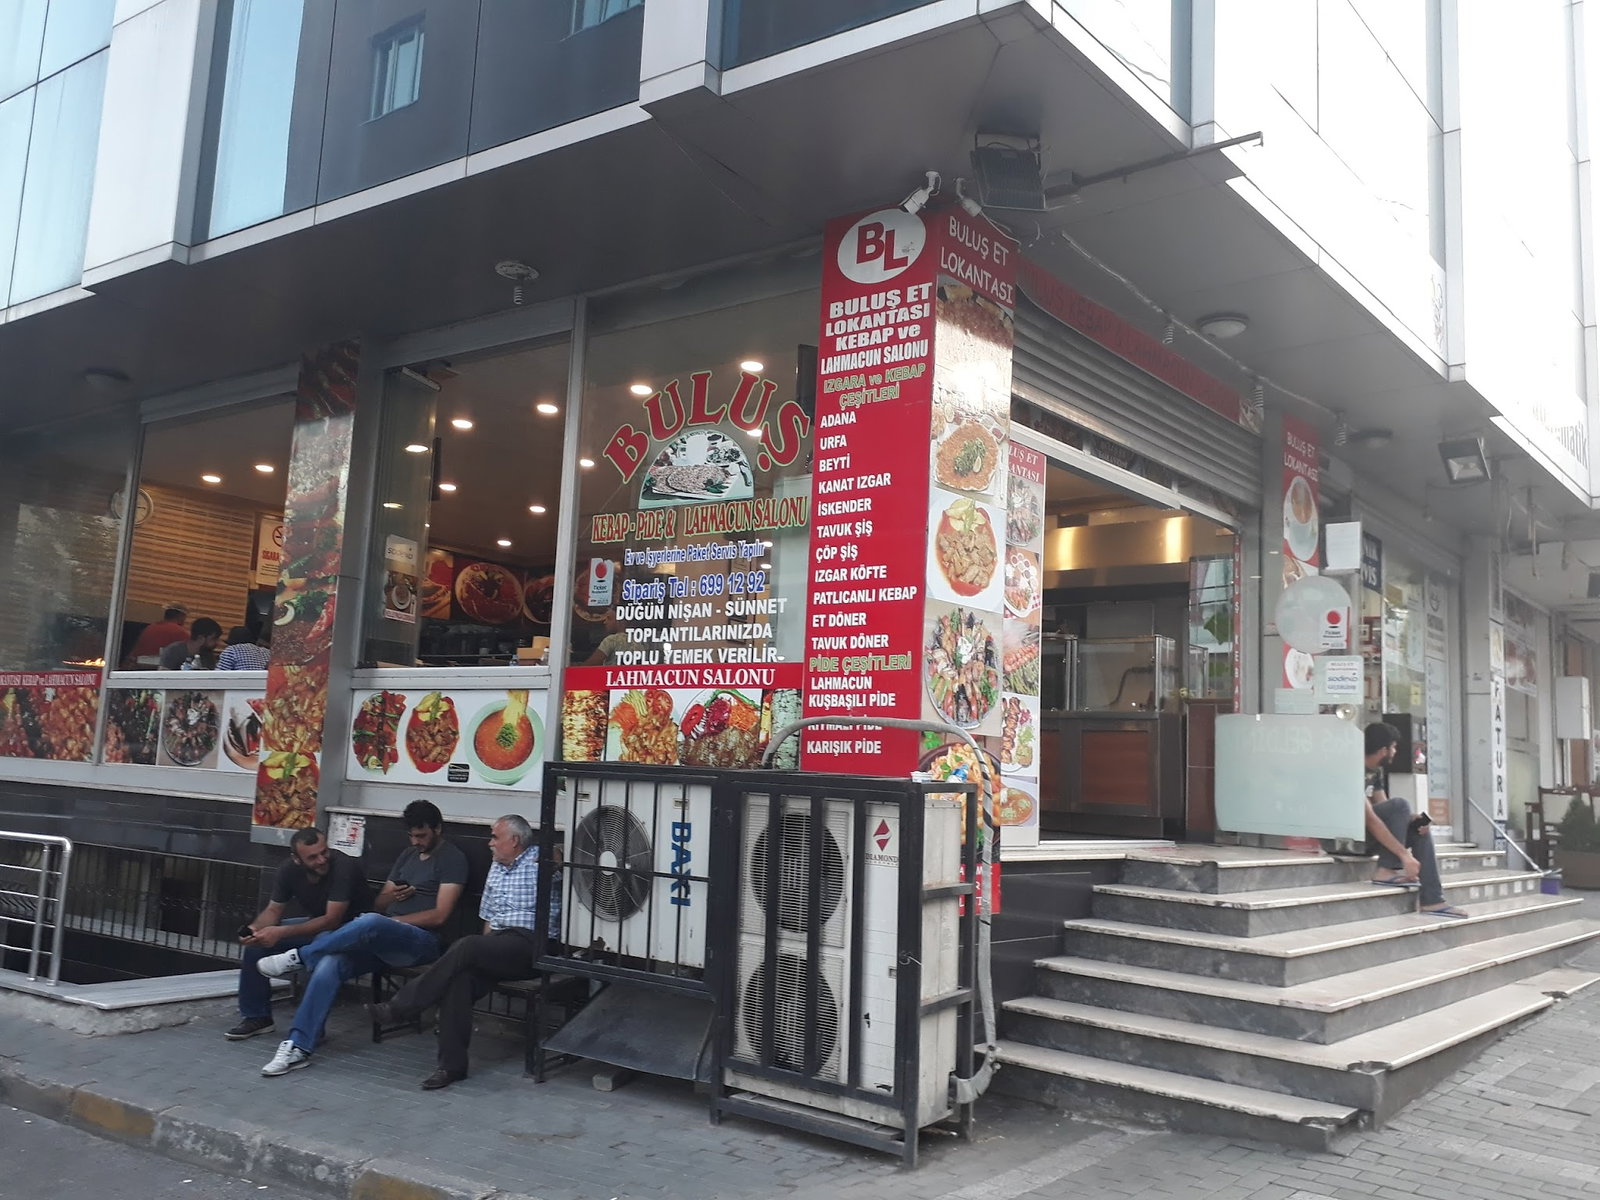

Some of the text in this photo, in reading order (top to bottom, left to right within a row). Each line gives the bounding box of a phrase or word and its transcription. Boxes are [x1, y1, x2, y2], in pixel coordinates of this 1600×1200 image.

[856, 221, 908, 271] BL
[949, 216, 1009, 267] BULUŞ ET
[940, 247, 1013, 305] LOKANTASI
[829, 282, 933, 319] BULUŞ ET
[825, 303, 931, 337] LOKANTASI
[836, 324, 921, 351] KEBAP ve
[821, 339, 929, 375] LAHMACUN SALONU
[823, 363, 926, 394] IZGARA ve KEBAP
[838, 382, 901, 411] ÇEŞİTLERİ
[602, 371, 810, 484] BULUŞ
[820, 411, 857, 429] ADANA
[819, 434, 848, 450] URFA
[818, 453, 851, 472] BEYTİ
[1009, 445, 1038, 465] LUŞ ET
[818, 472, 892, 494] KANAT IZGAR
[1010, 463, 1040, 482] ANTASI
[817, 498, 872, 516] İSKENDER
[591, 512, 630, 543] KEBAP
[664, 508, 677, 539] &
[683, 500, 753, 537] LAHMACUN
[754, 495, 809, 529] SALONU
[816, 521, 852, 538] TAVUK
[687, 544, 710, 562] Paket
[711, 541, 737, 560] Servis
[815, 544, 837, 563] ÇÖP
[814, 564, 887, 583] IZGAR KÖFTE
[622, 578, 666, 604] Sipariş
[668, 576, 689, 599] Tel
[699, 573, 724, 597] 699
[727, 571, 745, 595] 12
[747, 570, 766, 594] 92
[813, 586, 918, 605] PATLICANLI KEBAP
[616, 602, 665, 621] DÜĞÜN
[668, 600, 712, 623] NİŞAN
[724, 597, 788, 617] SÜNNET
[812, 611, 867, 628] ET DÖNER
[625, 623, 773, 644] TOPLANTILARINIZDA
[811, 633, 889, 651] TAVUK DÖNER
[615, 650, 659, 666] TOPLU
[663, 648, 712, 664] YEMEK
[809, 651, 912, 675] PİDE ÇEŞİTLERİ
[605, 668, 776, 687] LAHMACUN SALONU
[811, 676, 872, 690] LAHMACUN
[808, 690, 896, 712] KUŞBAŞILI PİDE
[806, 738, 882, 757] KARIŞIK PİDE
